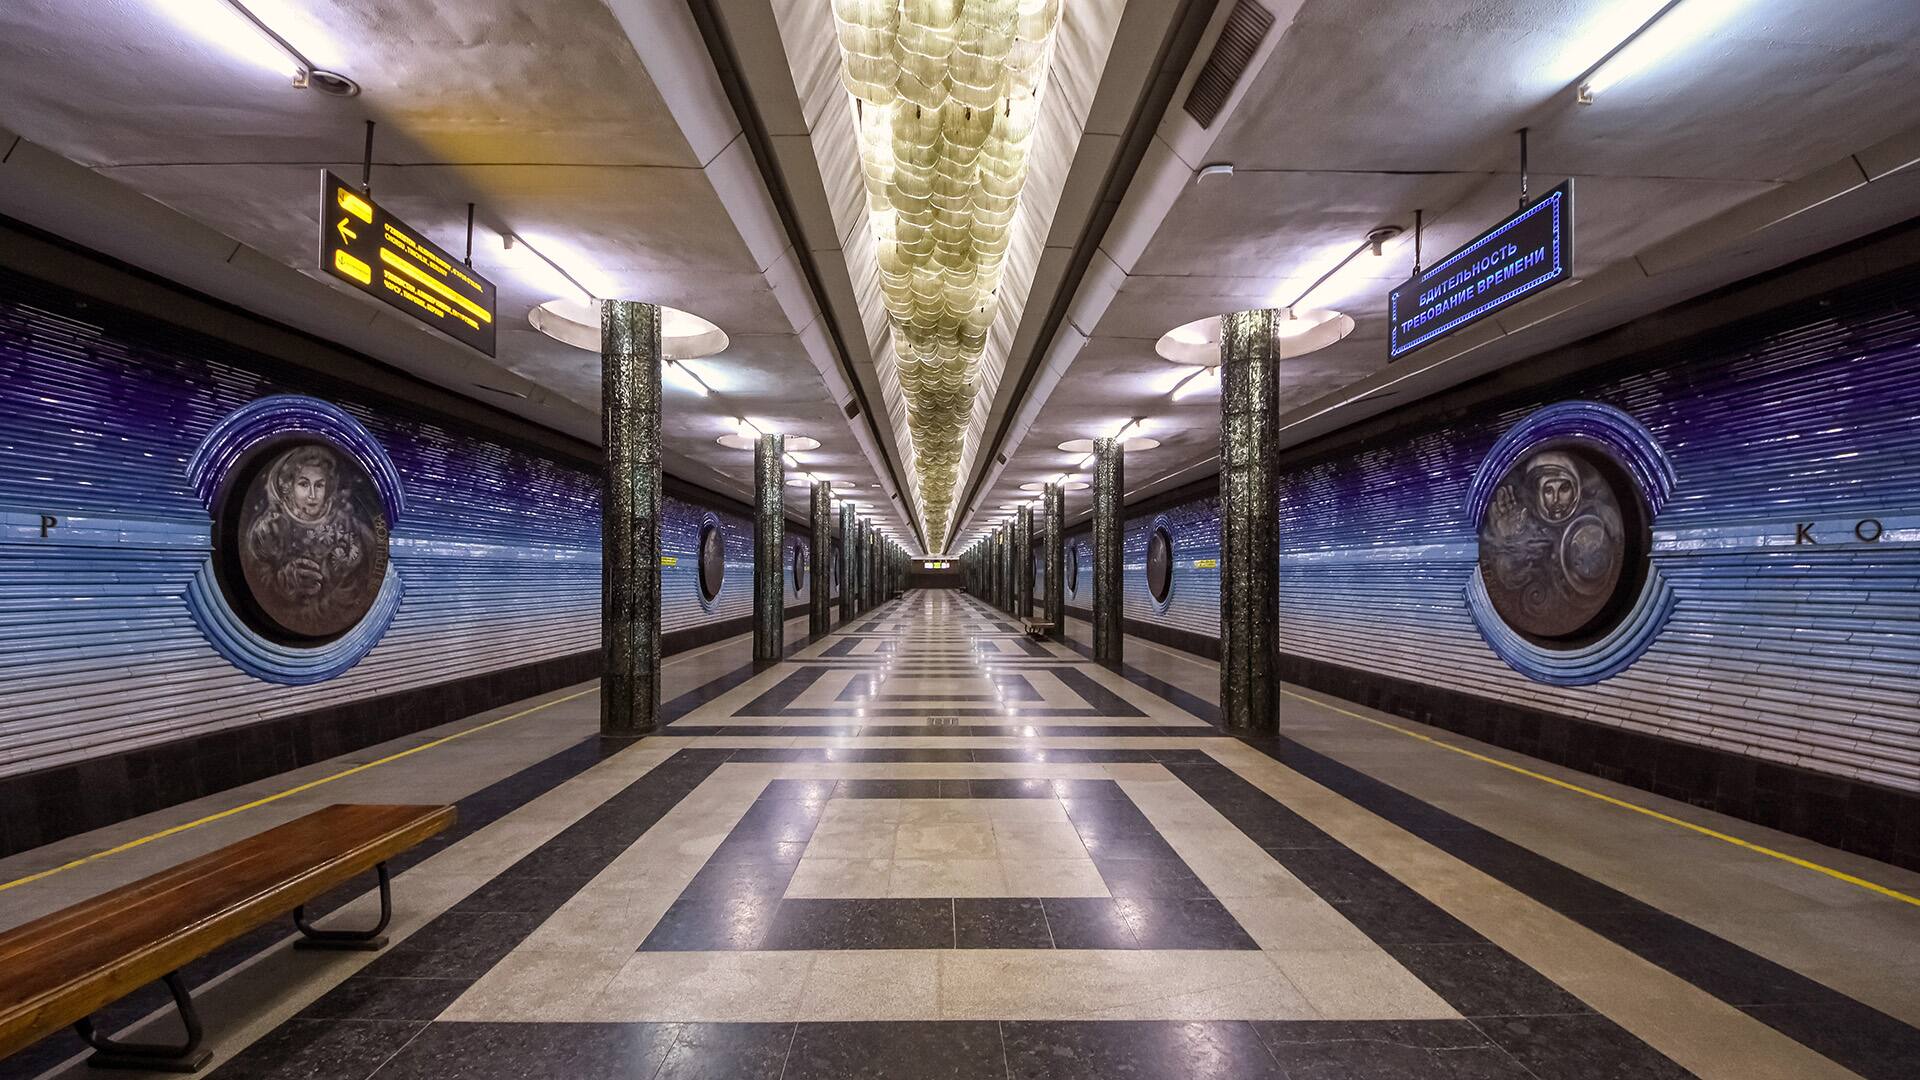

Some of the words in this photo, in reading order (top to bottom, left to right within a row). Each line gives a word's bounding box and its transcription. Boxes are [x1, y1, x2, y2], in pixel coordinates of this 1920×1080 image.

[1401, 284, 1475, 334] ТРЕБОВАНИЕ
[1477, 246, 1545, 294] ВРЕМЕНИ
[1418, 243, 1518, 307] БДИТЕЛЬНОСТЬ
